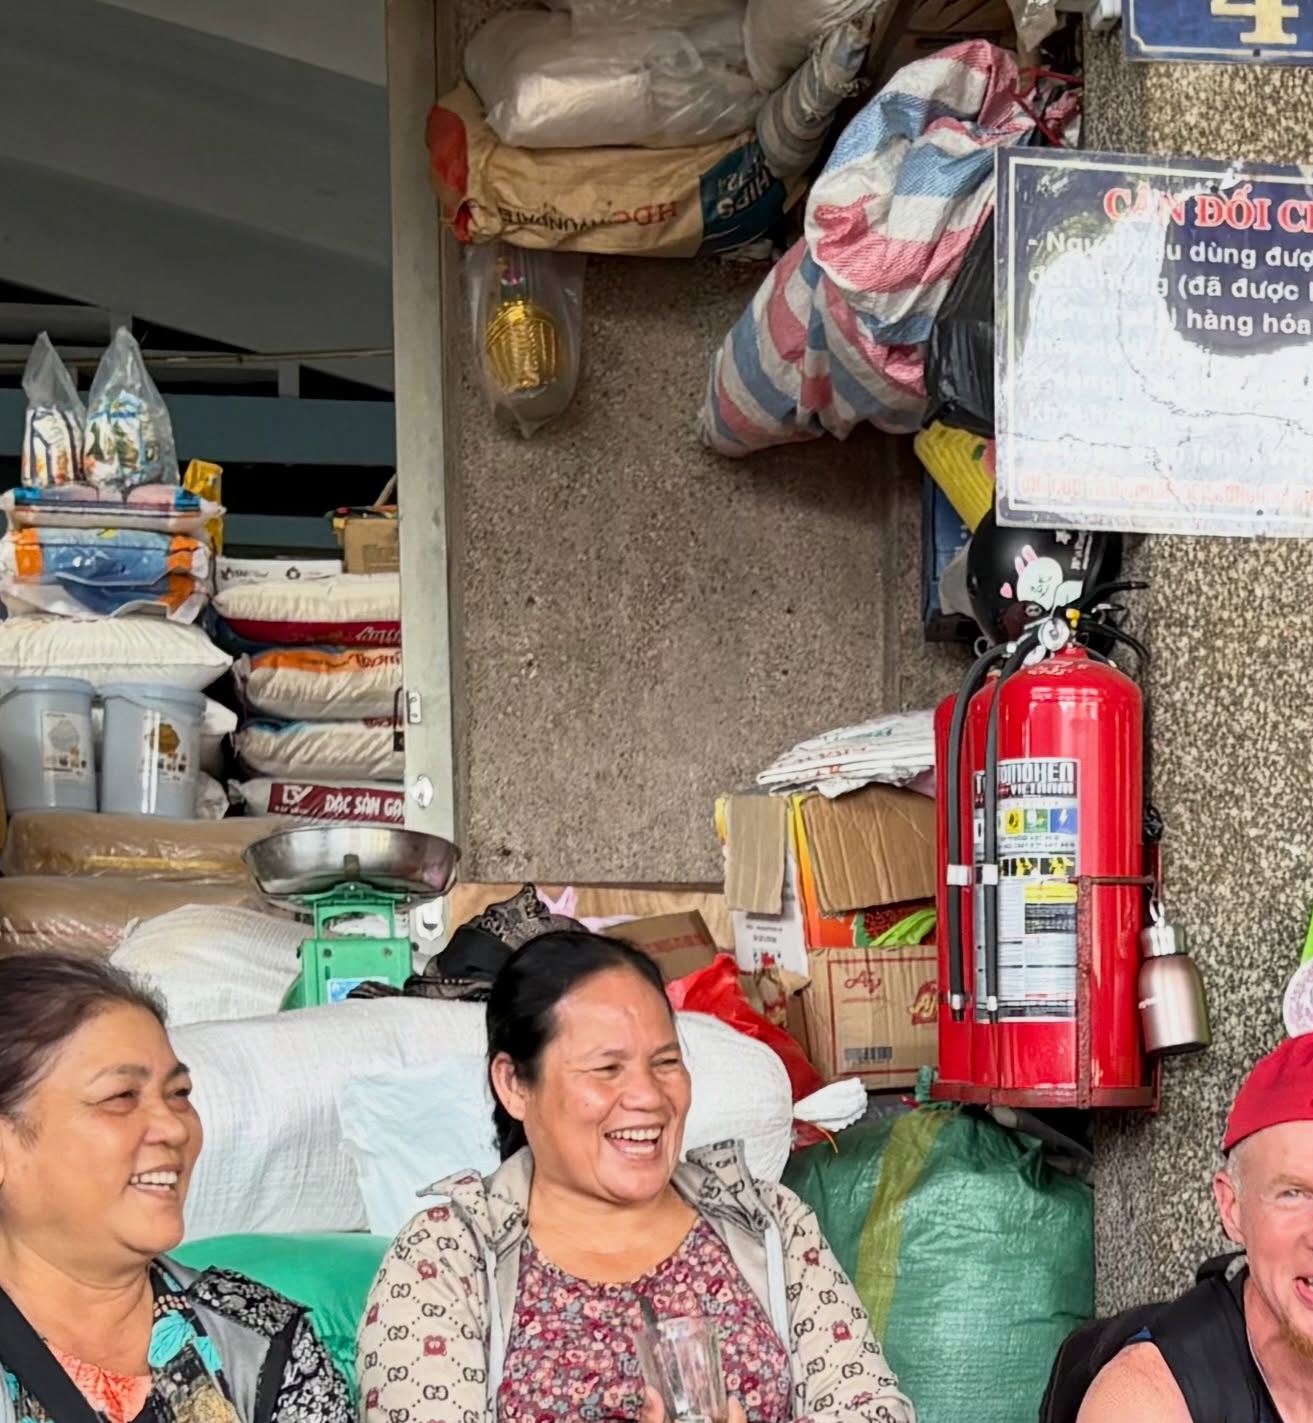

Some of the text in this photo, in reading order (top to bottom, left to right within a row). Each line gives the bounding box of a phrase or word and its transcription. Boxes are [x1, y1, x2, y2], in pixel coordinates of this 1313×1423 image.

[1195, 184, 1272, 231] ĐỐI
[1189, 242, 1257, 269] dùng
[1178, 274, 1222, 299] (đã
[1231, 278, 1300, 303] được
[1186, 308, 1254, 337] hàng
[1262, 311, 1312, 335] hóa
